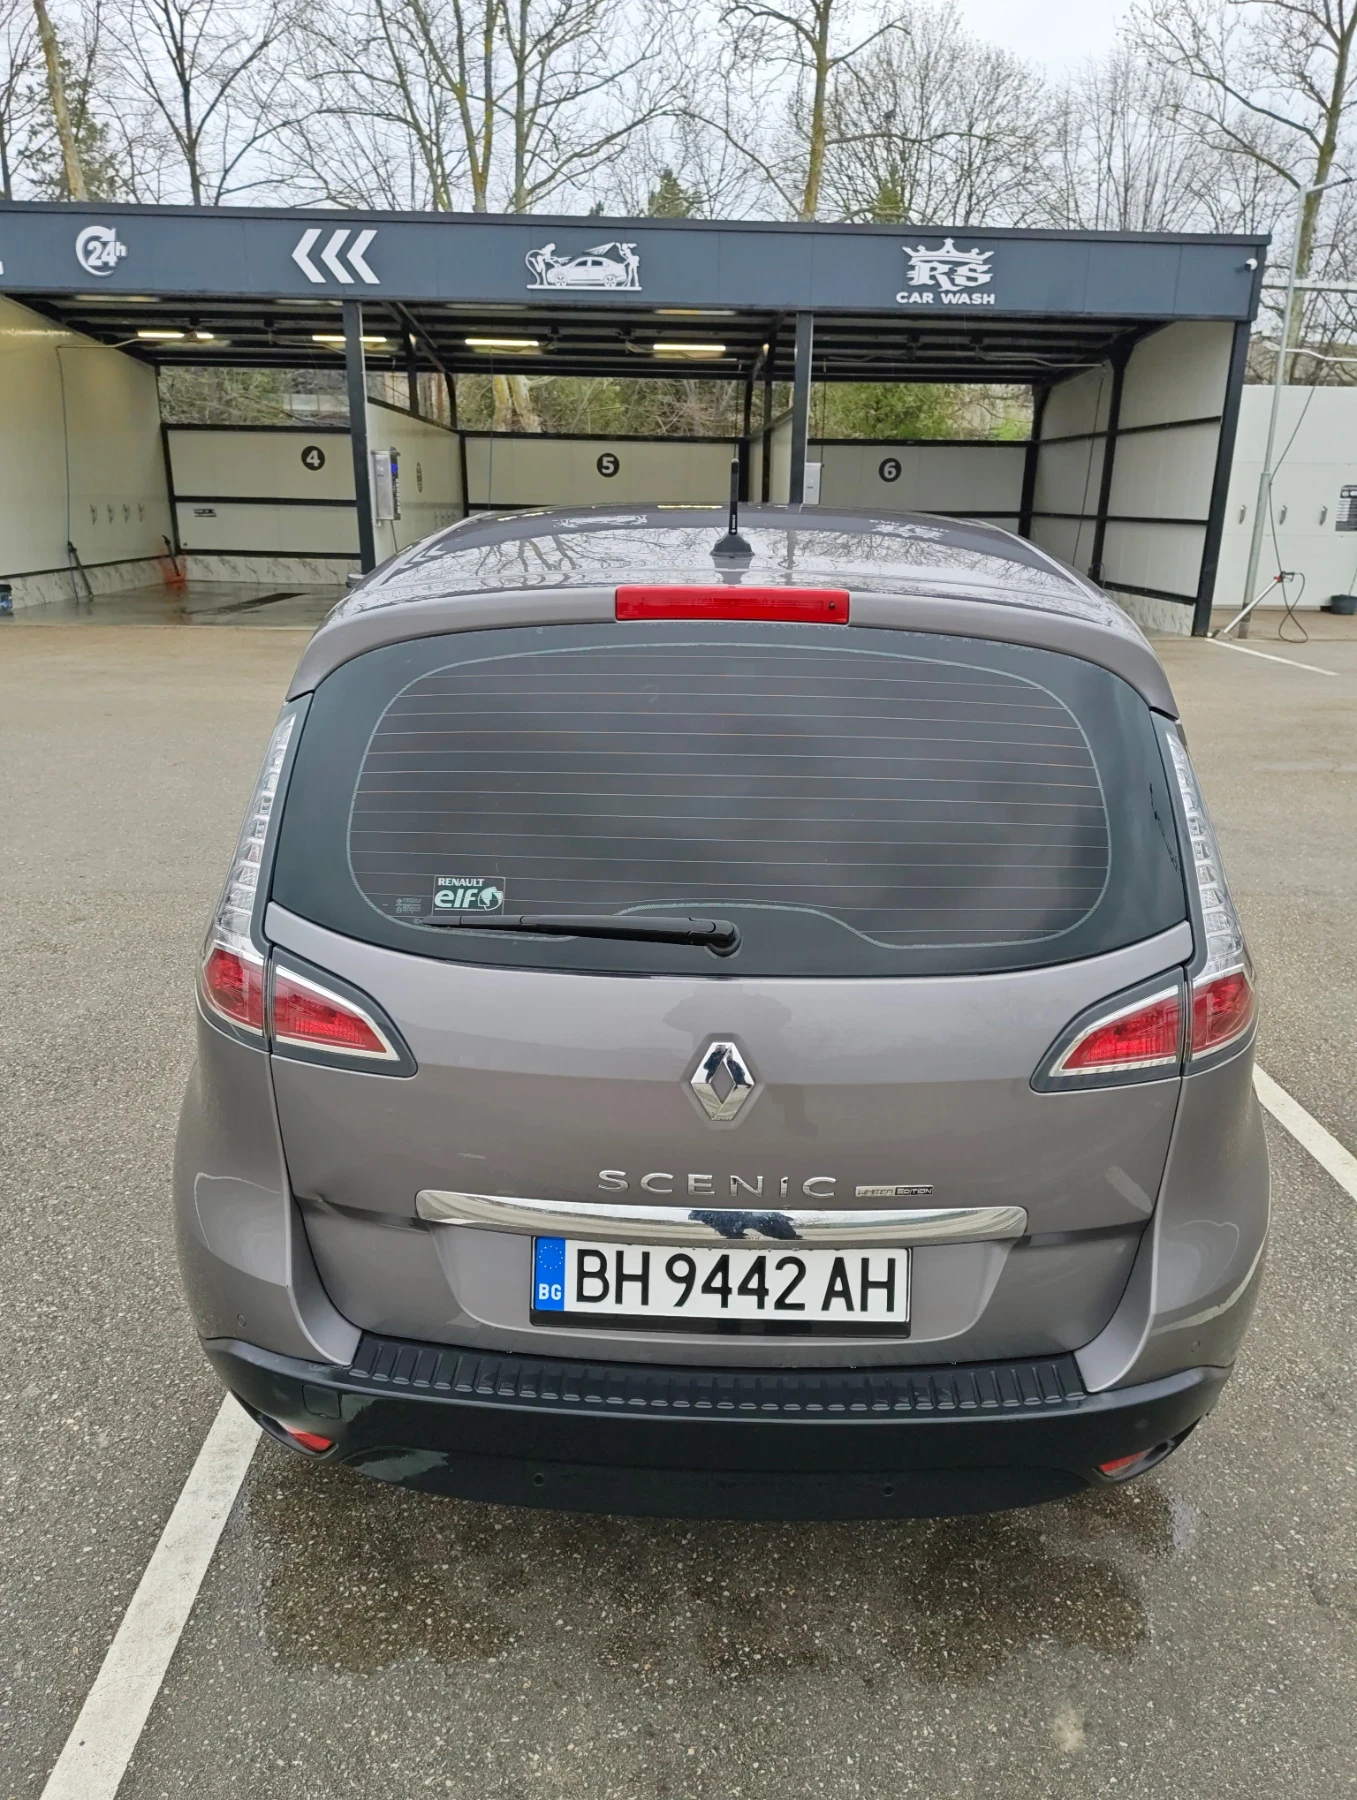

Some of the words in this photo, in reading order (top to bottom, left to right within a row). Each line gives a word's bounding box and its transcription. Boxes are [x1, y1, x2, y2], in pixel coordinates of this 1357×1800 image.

[87, 241, 127, 267] 24h
[896, 292, 934, 304] CAR
[940, 293, 995, 305] WASH
[306, 449, 321, 467] 4
[601, 456, 615, 474] 5
[883, 461, 897, 479] 6
[437, 877, 485, 887] RENAULT
[434, 888, 479, 909] elf
[598, 1170, 837, 1199] SCENIC
[896, 1187, 932, 1195] EDITION
[576, 1248, 650, 1306] BH
[665, 1252, 806, 1312] 9442
[821, 1256, 896, 1313] AH
[538, 1283, 562, 1301] BG
